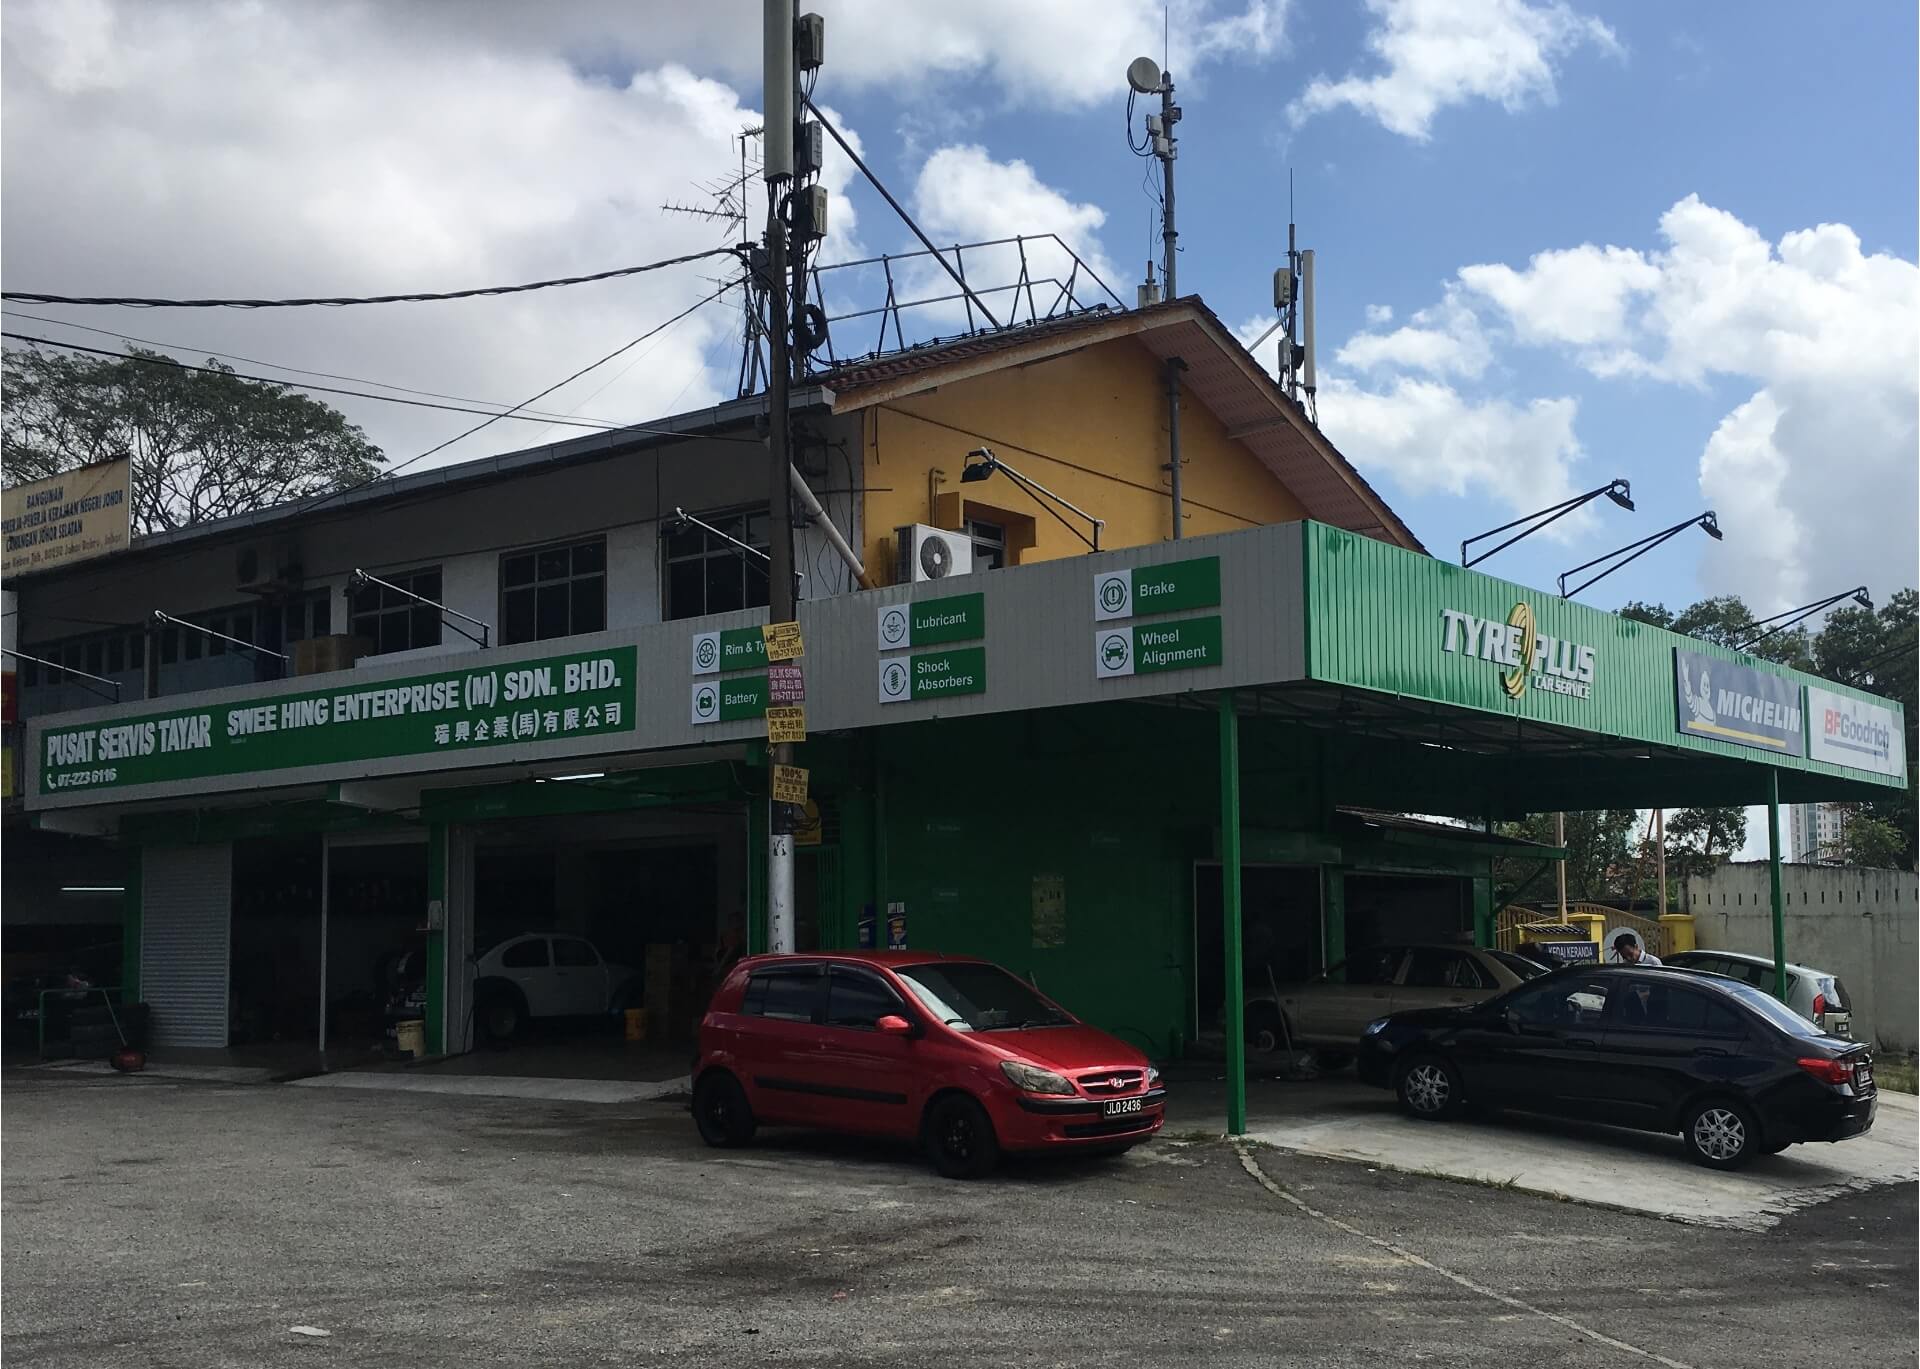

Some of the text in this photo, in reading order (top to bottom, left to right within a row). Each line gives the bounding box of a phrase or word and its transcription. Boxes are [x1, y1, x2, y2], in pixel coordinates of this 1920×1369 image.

[27, 487, 63, 509] BANGUNAN
[80, 495, 101, 513] NEGERI
[102, 489, 123, 508] JOHOR
[59, 519, 82, 539] SELATAN
[1140, 581, 1175, 597] Brake
[916, 611, 966, 629] Lubricant
[1141, 629, 1179, 646] Wheel
[1442, 608, 1596, 683] TYRE PLUS
[725, 644, 743, 656] Rim
[745, 641, 752, 653] &
[755, 640, 766, 654] Ty
[1142, 645, 1206, 665] Alignment
[917, 659, 950, 674] Shock
[917, 675, 973, 691] Absorbers
[1534, 675, 1591, 699] CAR SERVICE
[227, 658, 621, 737] SWEE HING ENTERPRISE (M) SDN. BHD.
[725, 693, 758, 705] Battery
[1717, 688, 1800, 733] MICHELIN
[1824, 708, 1889, 748] BFGoodrich
[47, 714, 212, 767] PUSAT SERVIS TAYAR
[57, 767, 117, 787] 07-223 6116
[780, 767, 803, 780] 100%
[1122, 1099, 1141, 1113] 2436
